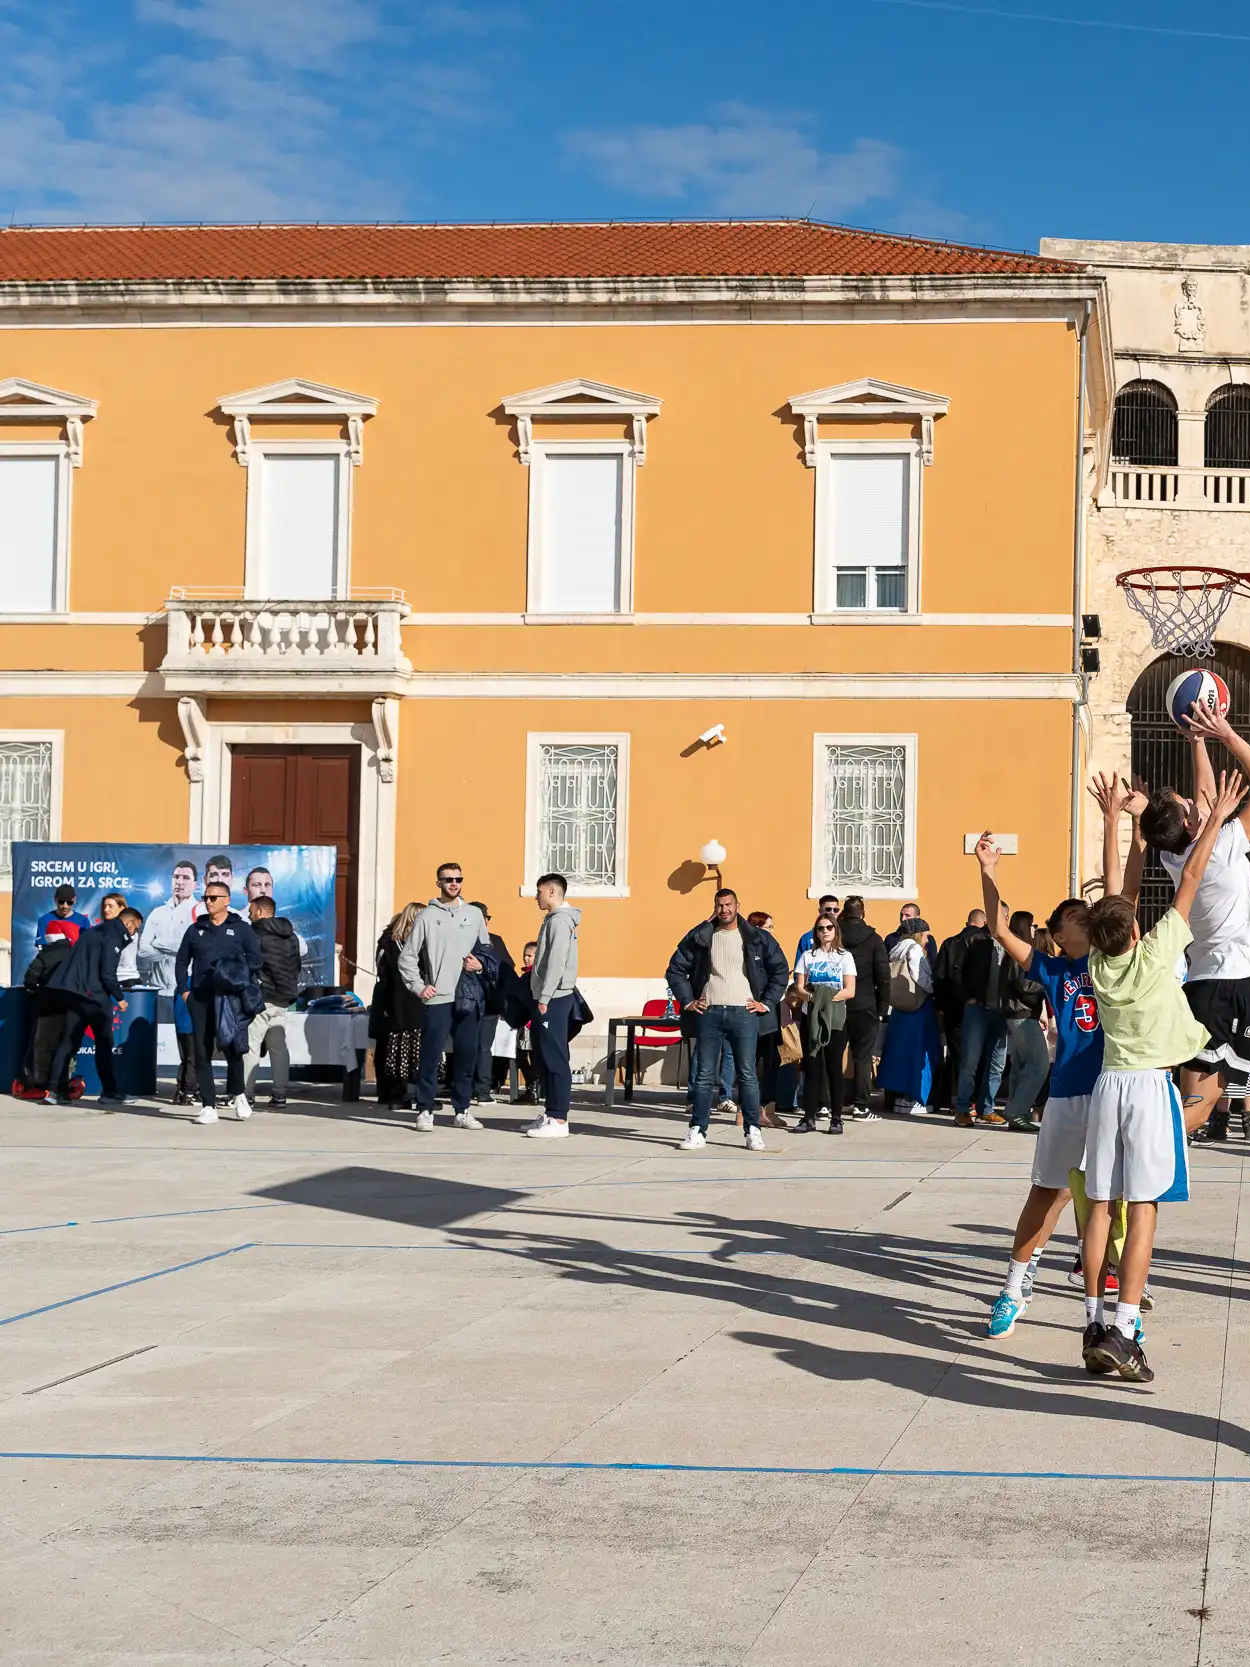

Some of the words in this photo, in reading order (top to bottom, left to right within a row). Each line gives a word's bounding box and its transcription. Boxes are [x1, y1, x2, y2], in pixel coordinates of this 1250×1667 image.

[31, 860, 75, 873] SRCEM
[77, 861, 86, 873] U
[90, 861, 119, 875] IGRI,
[31, 875, 75, 888] IGROM
[78, 876, 95, 888] ZA
[98, 877, 132, 889] SRCE.
[1075, 994, 1100, 1032] 3
